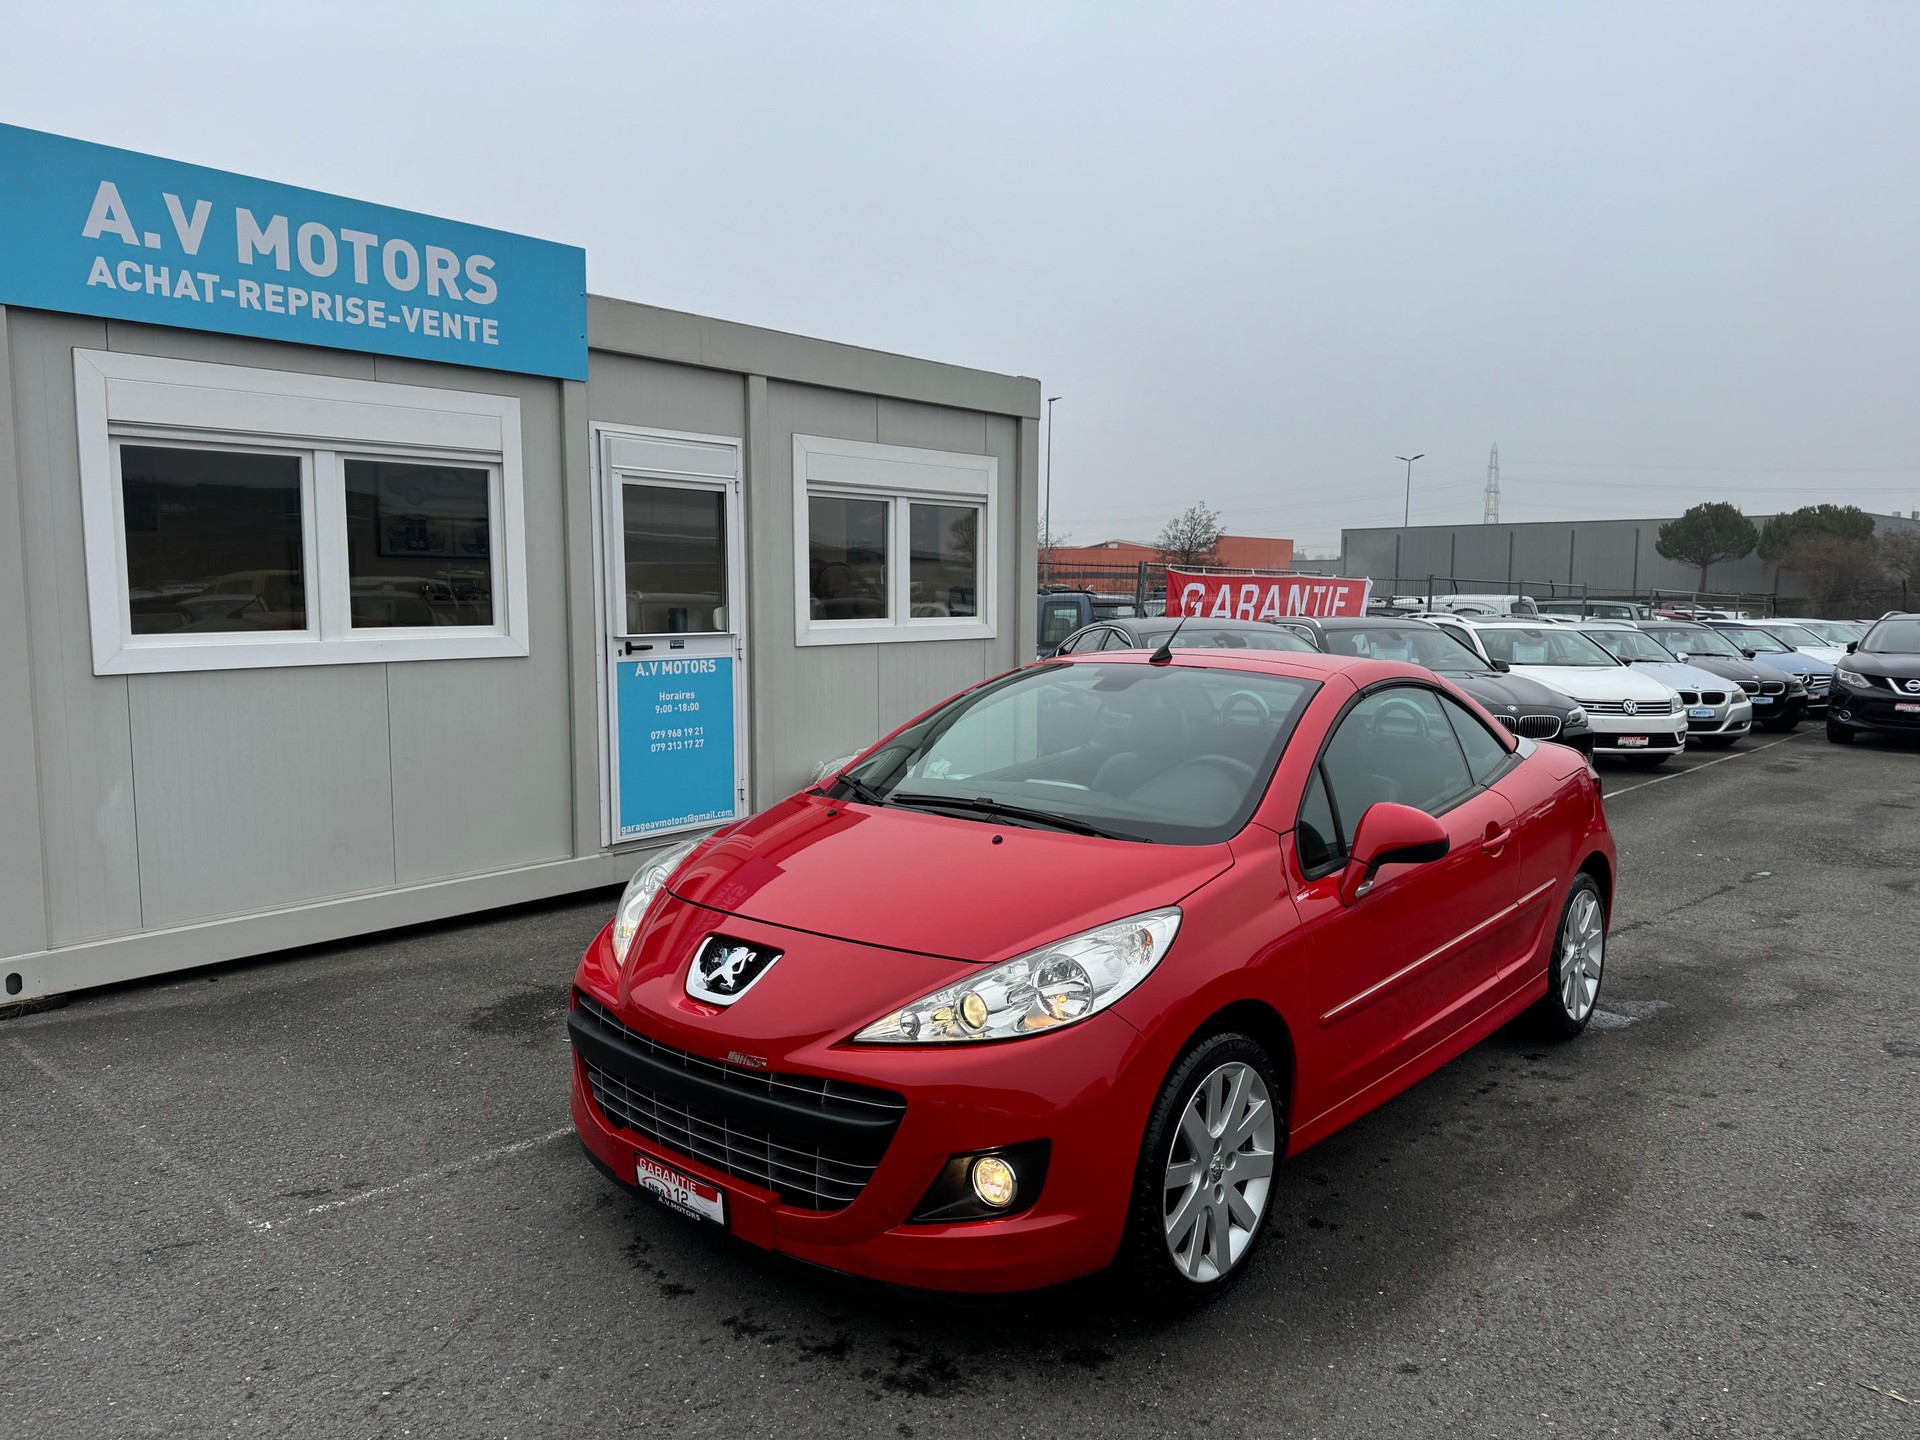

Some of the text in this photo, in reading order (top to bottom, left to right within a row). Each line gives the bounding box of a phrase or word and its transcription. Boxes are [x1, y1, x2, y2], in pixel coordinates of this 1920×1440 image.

[81, 180, 499, 305] A.V MOTORS
[86, 256, 500, 347] ACHAT-REPRISE-VENTE
[1180, 582, 1349, 621] GARANTIE
[635, 659, 716, 677] A.V MOTORS
[659, 691, 696, 701] Horaires
[655, 704, 672, 714] 9:00
[650, 726, 704, 740] 079 968 19 21
[651, 739, 704, 753] 079 313 17 27
[621, 809, 733, 835] garageavmotors@gmail.com
[639, 1158, 697, 1195] GARANTIE
[648, 1182, 689, 1206] NSA 12
